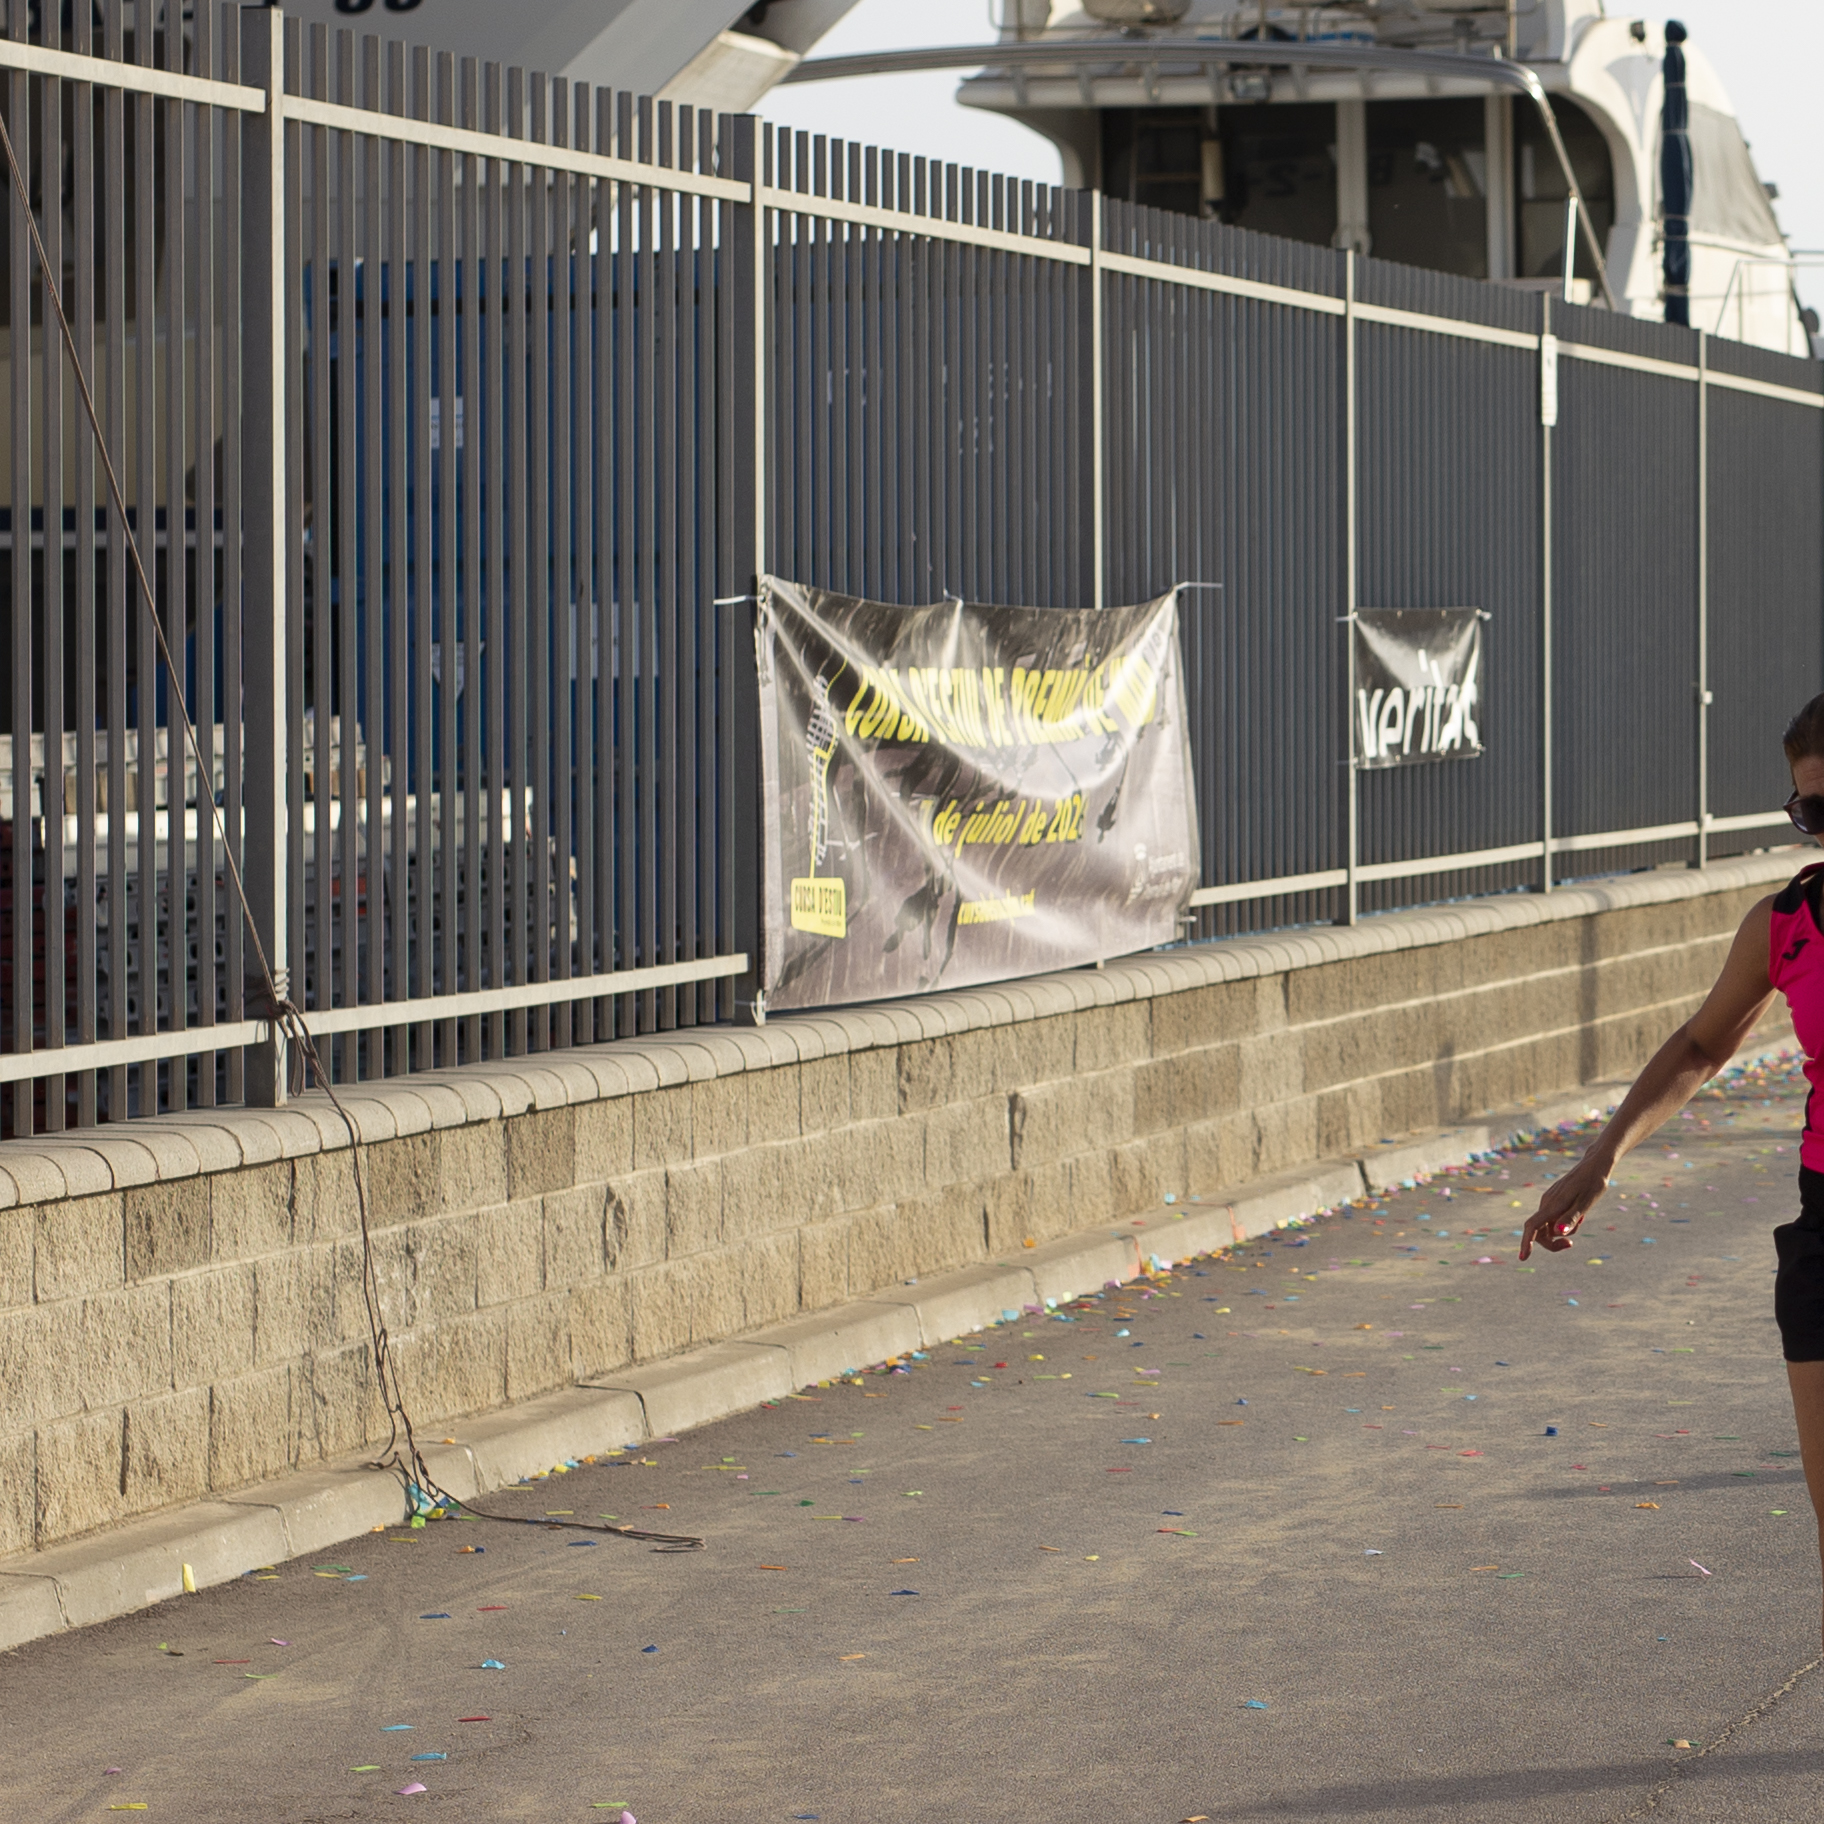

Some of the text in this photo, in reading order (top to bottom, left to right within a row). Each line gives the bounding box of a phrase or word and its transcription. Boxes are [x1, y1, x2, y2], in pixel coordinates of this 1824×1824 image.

[933, 799, 962, 846] de
[955, 799, 1026, 858] juliol
[1019, 798, 1047, 846] de
